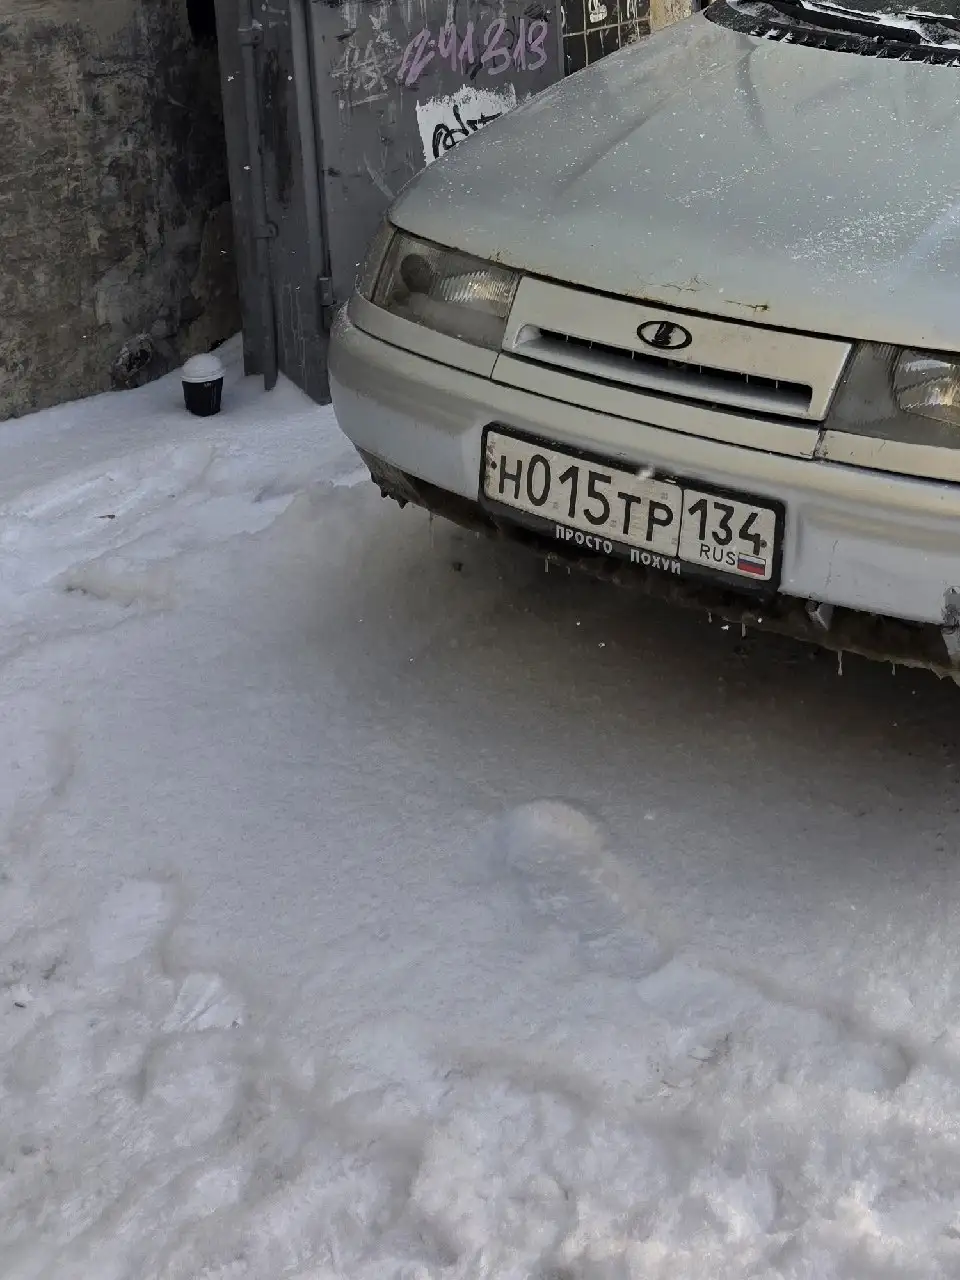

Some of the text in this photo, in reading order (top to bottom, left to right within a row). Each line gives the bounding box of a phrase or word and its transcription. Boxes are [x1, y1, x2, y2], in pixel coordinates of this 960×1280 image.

[499, 454, 763, 556] Н015ТР 134
[555, 524, 613, 554] ПРОСТО
[699, 543, 736, 566] RUS
